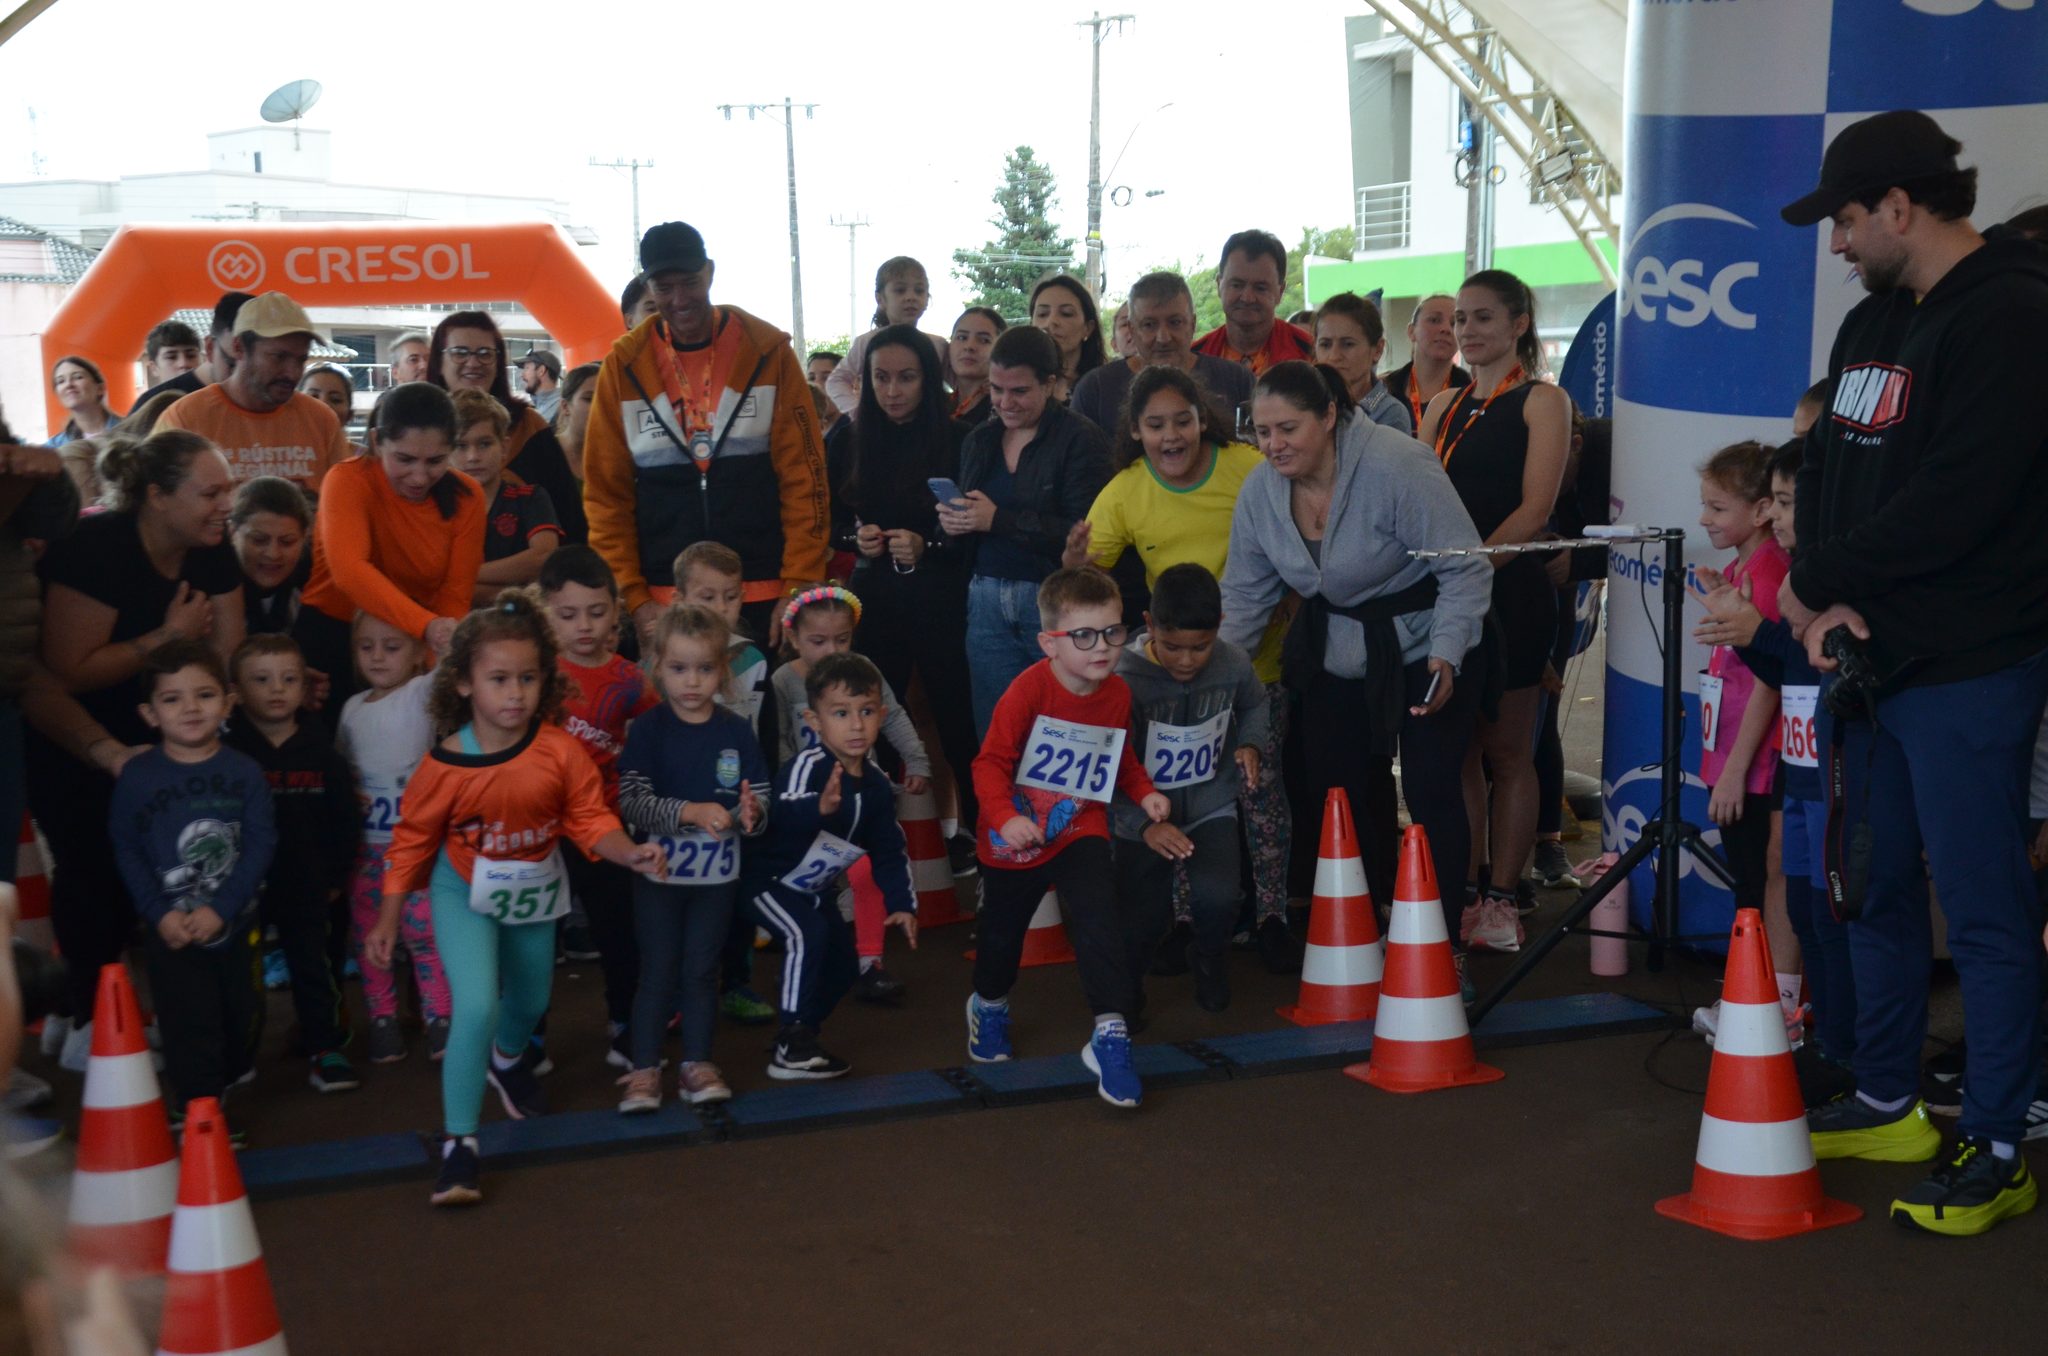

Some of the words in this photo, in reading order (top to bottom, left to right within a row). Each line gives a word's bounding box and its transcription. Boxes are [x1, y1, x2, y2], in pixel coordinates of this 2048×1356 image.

[284, 243, 490, 284] CRESOL
[238, 442, 318, 462] RÚSTICA
[1026, 743, 1112, 793] 2215
[1153, 735, 1222, 783] 2205
[657, 836, 735, 877] 2275
[489, 880, 562, 920] 357
[1829, 871, 1843, 902] Canon
